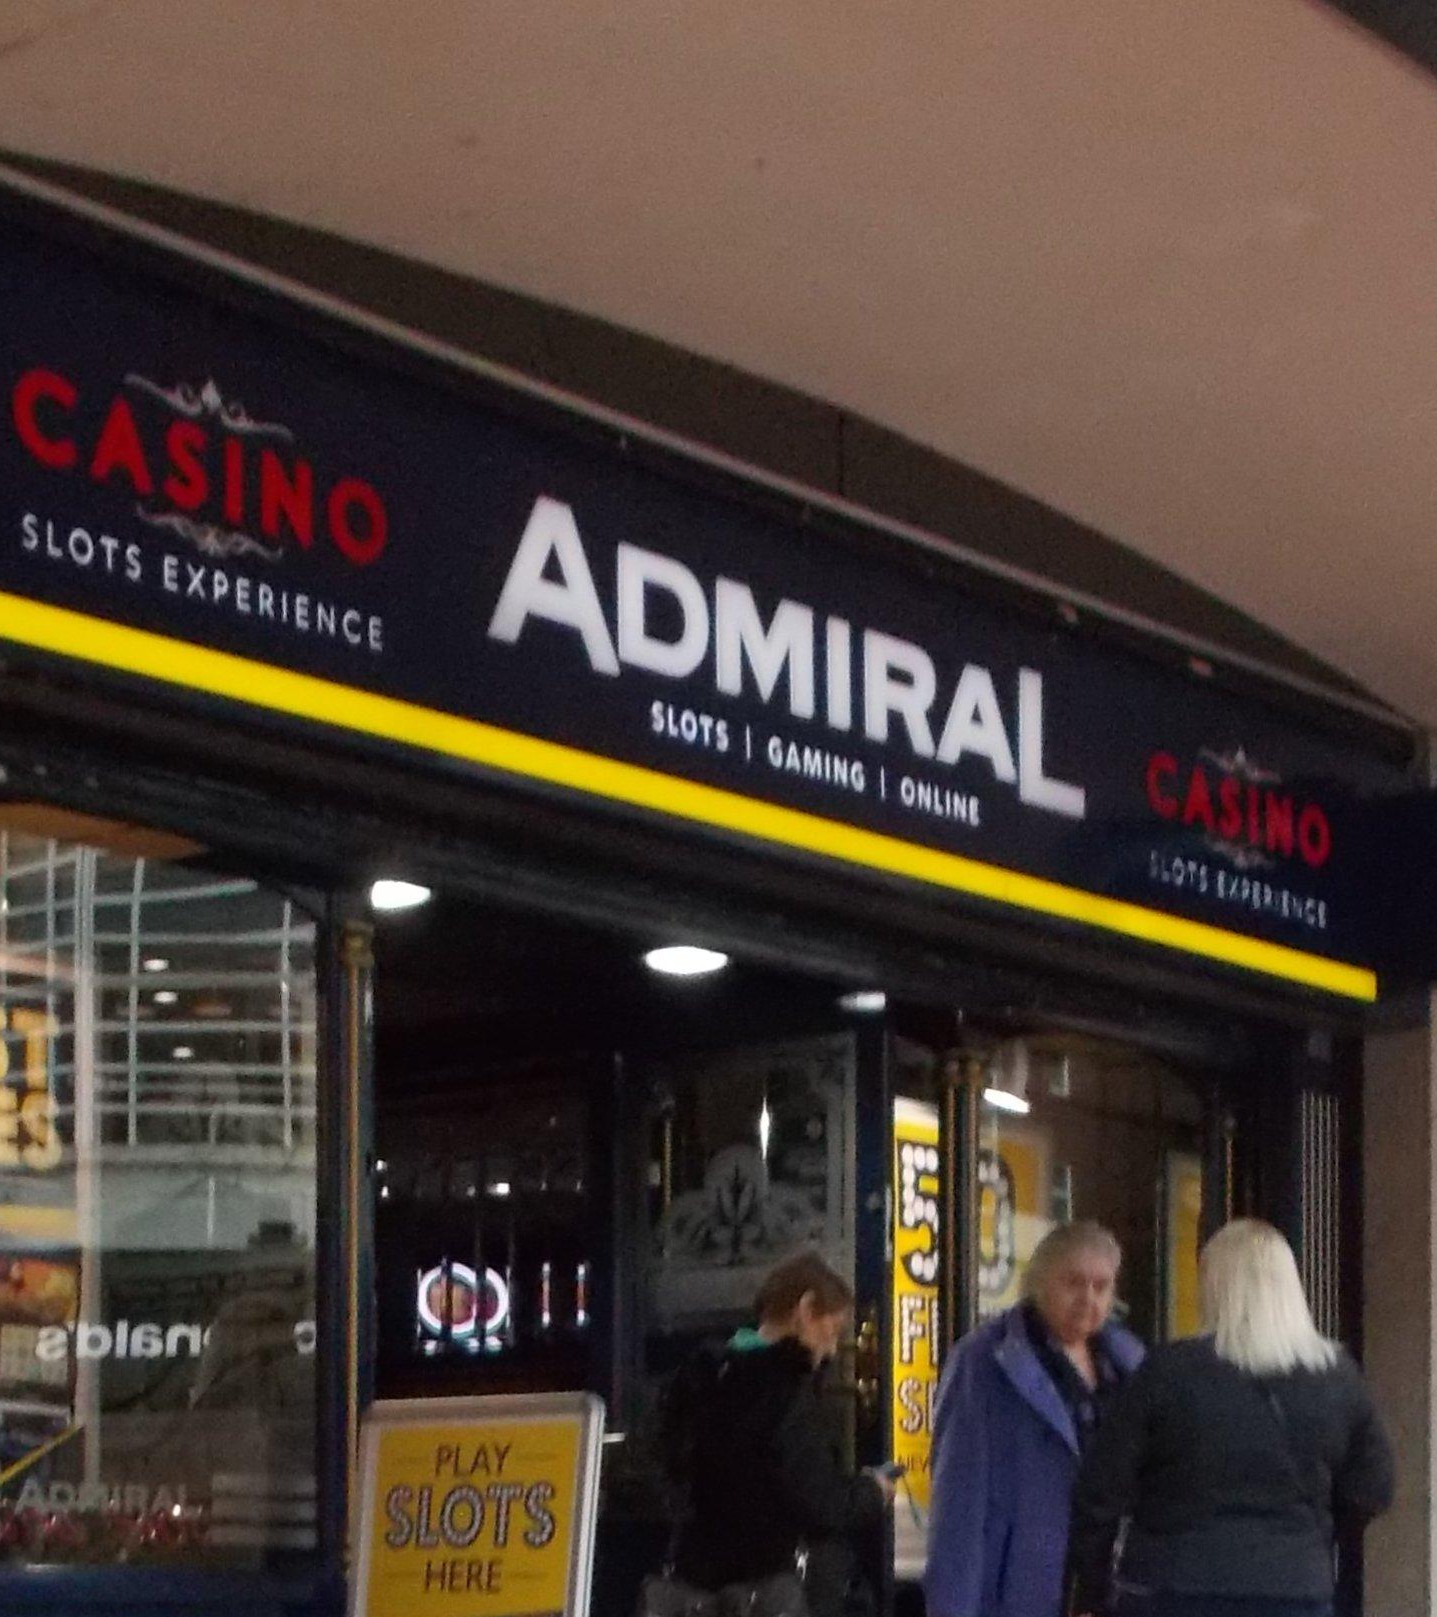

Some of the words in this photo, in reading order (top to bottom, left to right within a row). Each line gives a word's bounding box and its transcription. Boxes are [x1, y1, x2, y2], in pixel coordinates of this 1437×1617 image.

[13, 367, 389, 565] CASINO
[22, 514, 142, 580] SLOTS
[164, 556, 384, 651] EXPERIENCE
[488, 494, 1086, 818] ADMIRAL
[650, 701, 730, 753] SLOTS
[768, 738, 865, 792] GAMING
[901, 776, 980, 826] ONLINE
[1146, 752, 1331, 869] CASINO
[1150, 850, 1208, 892] SLOTS
[1217, 870, 1327, 929] EXPERIENCE
[385, 1481, 556, 1550] SLOTS
[435, 1443, 513, 1478] PLAY
[424, 1559, 503, 1594] HERE
